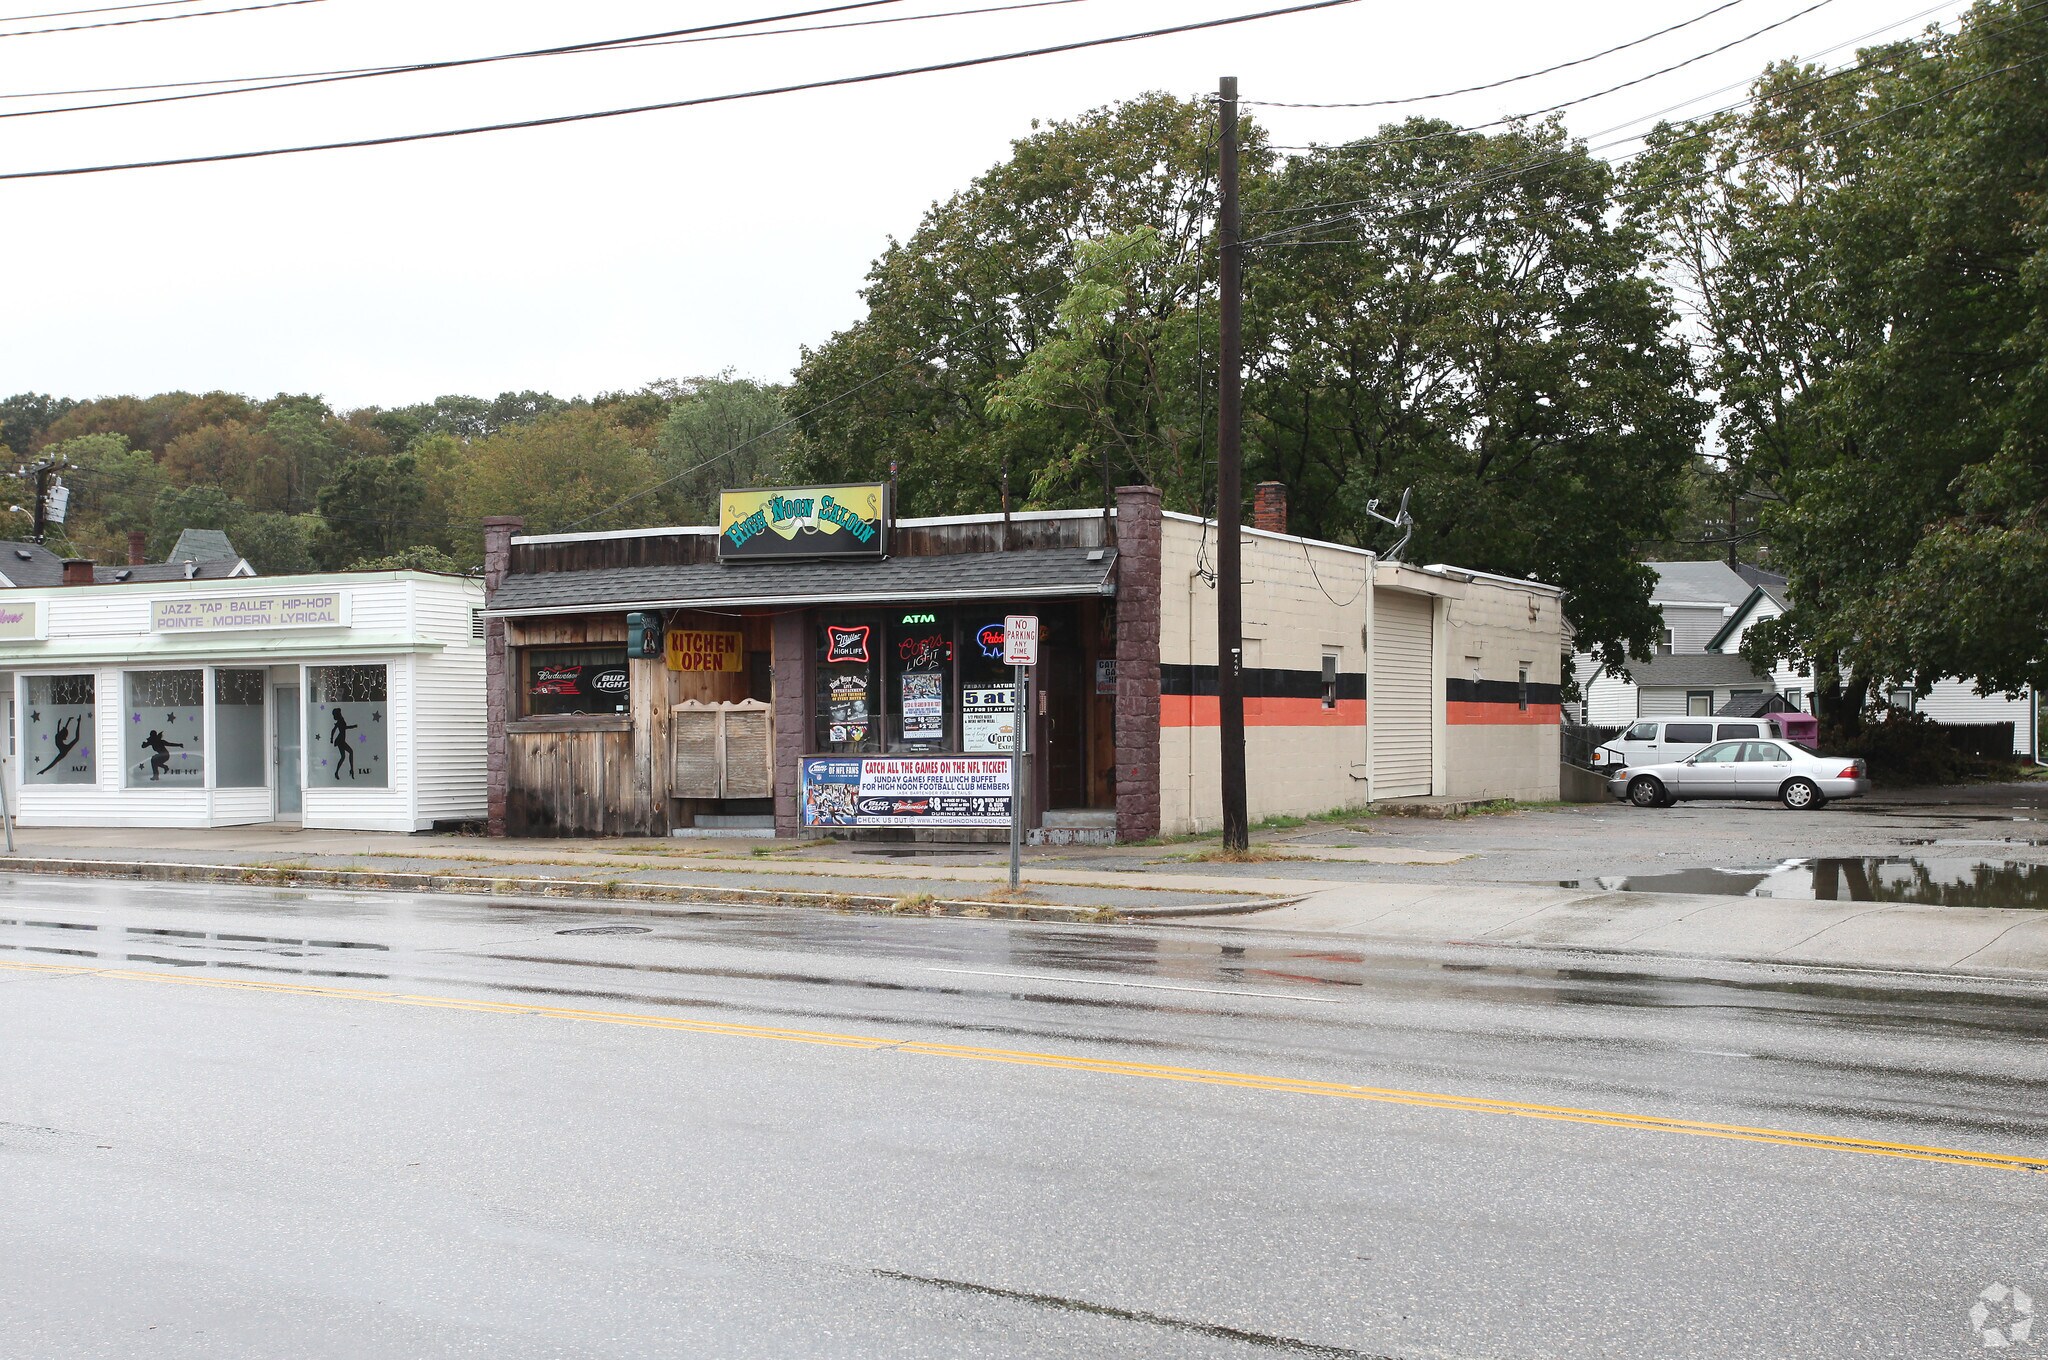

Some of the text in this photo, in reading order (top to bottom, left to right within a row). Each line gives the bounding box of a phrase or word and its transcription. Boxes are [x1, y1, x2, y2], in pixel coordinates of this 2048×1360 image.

[726, 495, 876, 548] HIGH NOON SALOON
[162, 598, 332, 614] JAZZ TAP BALLET HIP-HOP
[158, 612, 335, 628] POINTE MODERN LYRICAL
[902, 614, 936, 624] ATM
[1015, 620, 1027, 629] NO
[836, 634, 862, 647] Miller
[982, 631, 1004, 644] Pabs
[1008, 631, 1035, 640] PARKING
[672, 632, 735, 653] KITCHEN
[898, 634, 944, 659] Coors
[682, 652, 723, 671] OPEN
[965, 692, 978, 704] 5
[984, 692, 1005, 704] at
[865, 761, 1007, 774] CATCH ALL THE GAMES ON THE NFL TICKET!
[929, 797, 941, 811] $8
[973, 798, 984, 811] $2
